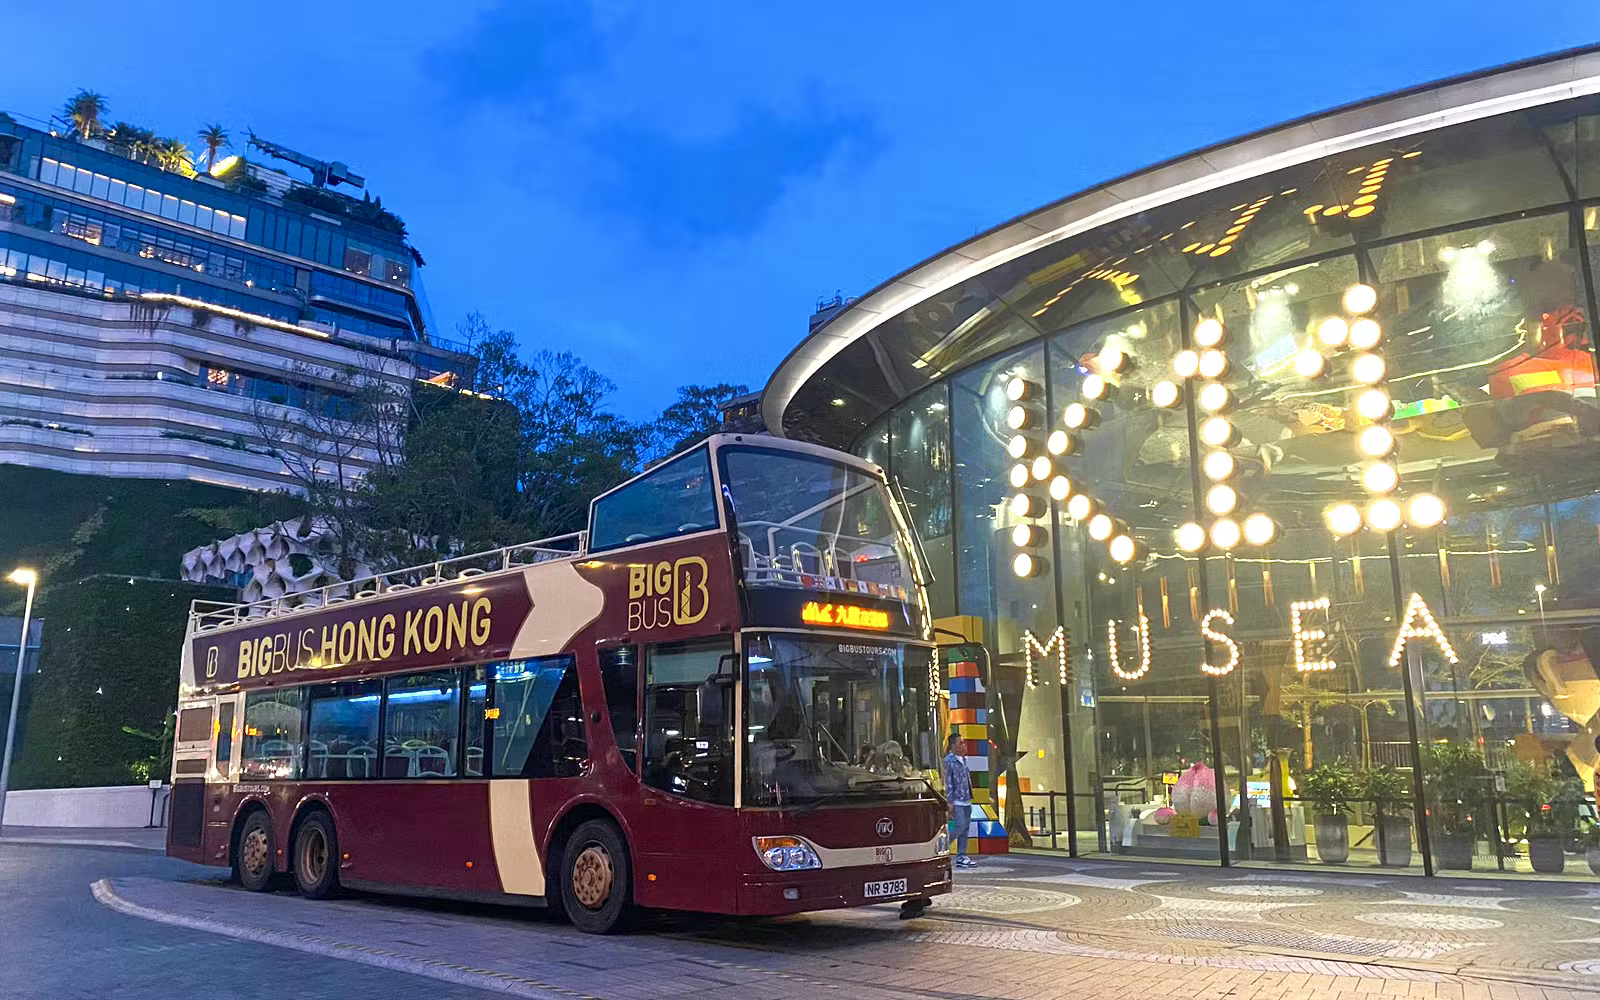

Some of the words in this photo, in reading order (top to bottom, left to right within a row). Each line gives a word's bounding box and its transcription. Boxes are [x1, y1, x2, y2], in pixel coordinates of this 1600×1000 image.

[1006, 283, 1446, 578] K11
[629, 561, 671, 599] BIG
[320, 613, 396, 664] HONG
[403, 597, 492, 656] KONG
[628, 597, 671, 631] BUS
[838, 644, 897, 656] BIGBUSTOURS.COM
[1024, 592, 1459, 689] MUSEA
[867, 883, 880, 896] NR
[882, 881, 905, 893] 9783
